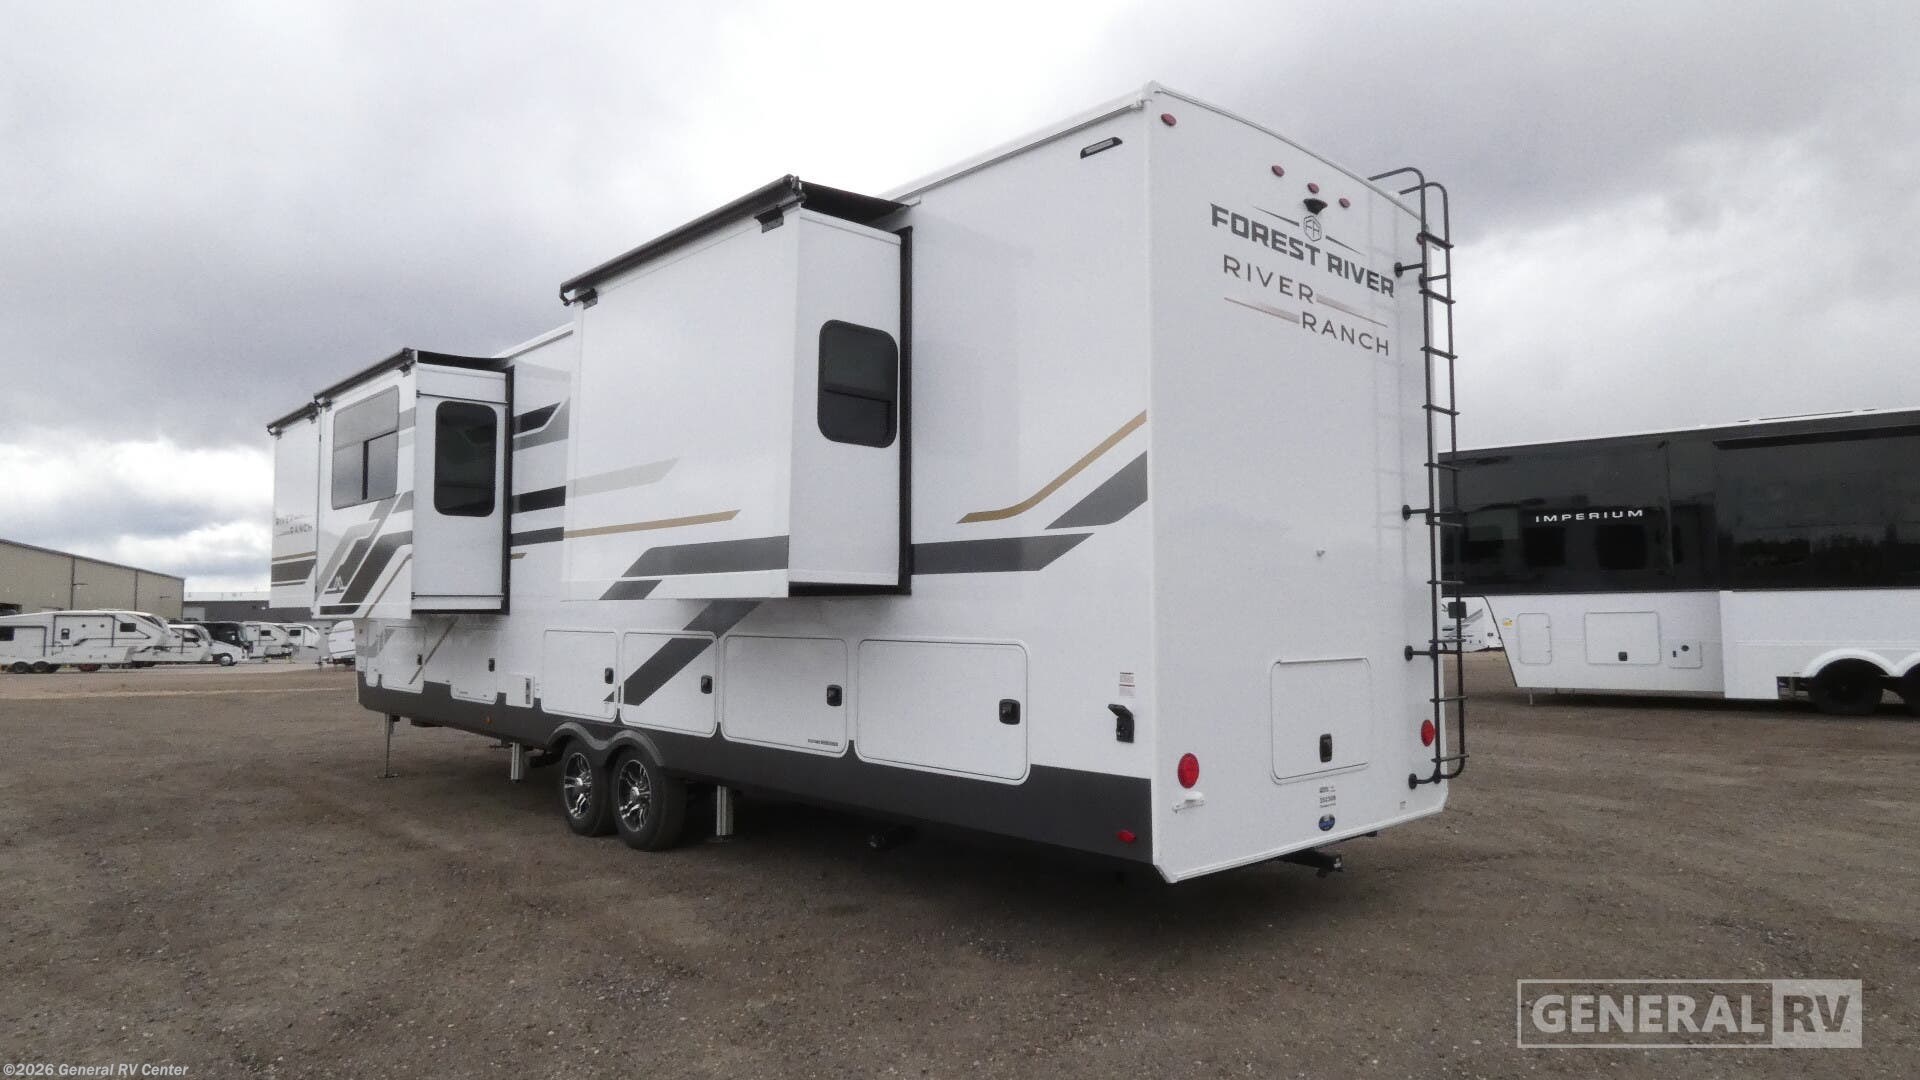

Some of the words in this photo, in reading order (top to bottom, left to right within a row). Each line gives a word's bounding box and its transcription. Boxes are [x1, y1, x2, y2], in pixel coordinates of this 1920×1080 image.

[1210, 202, 1321, 266] FOREST
[1326, 251, 1395, 299] RIVER
[1223, 253, 1314, 305] RIVER
[1302, 311, 1390, 357] RANCH
[1535, 509, 1643, 523] IMPERIUM
